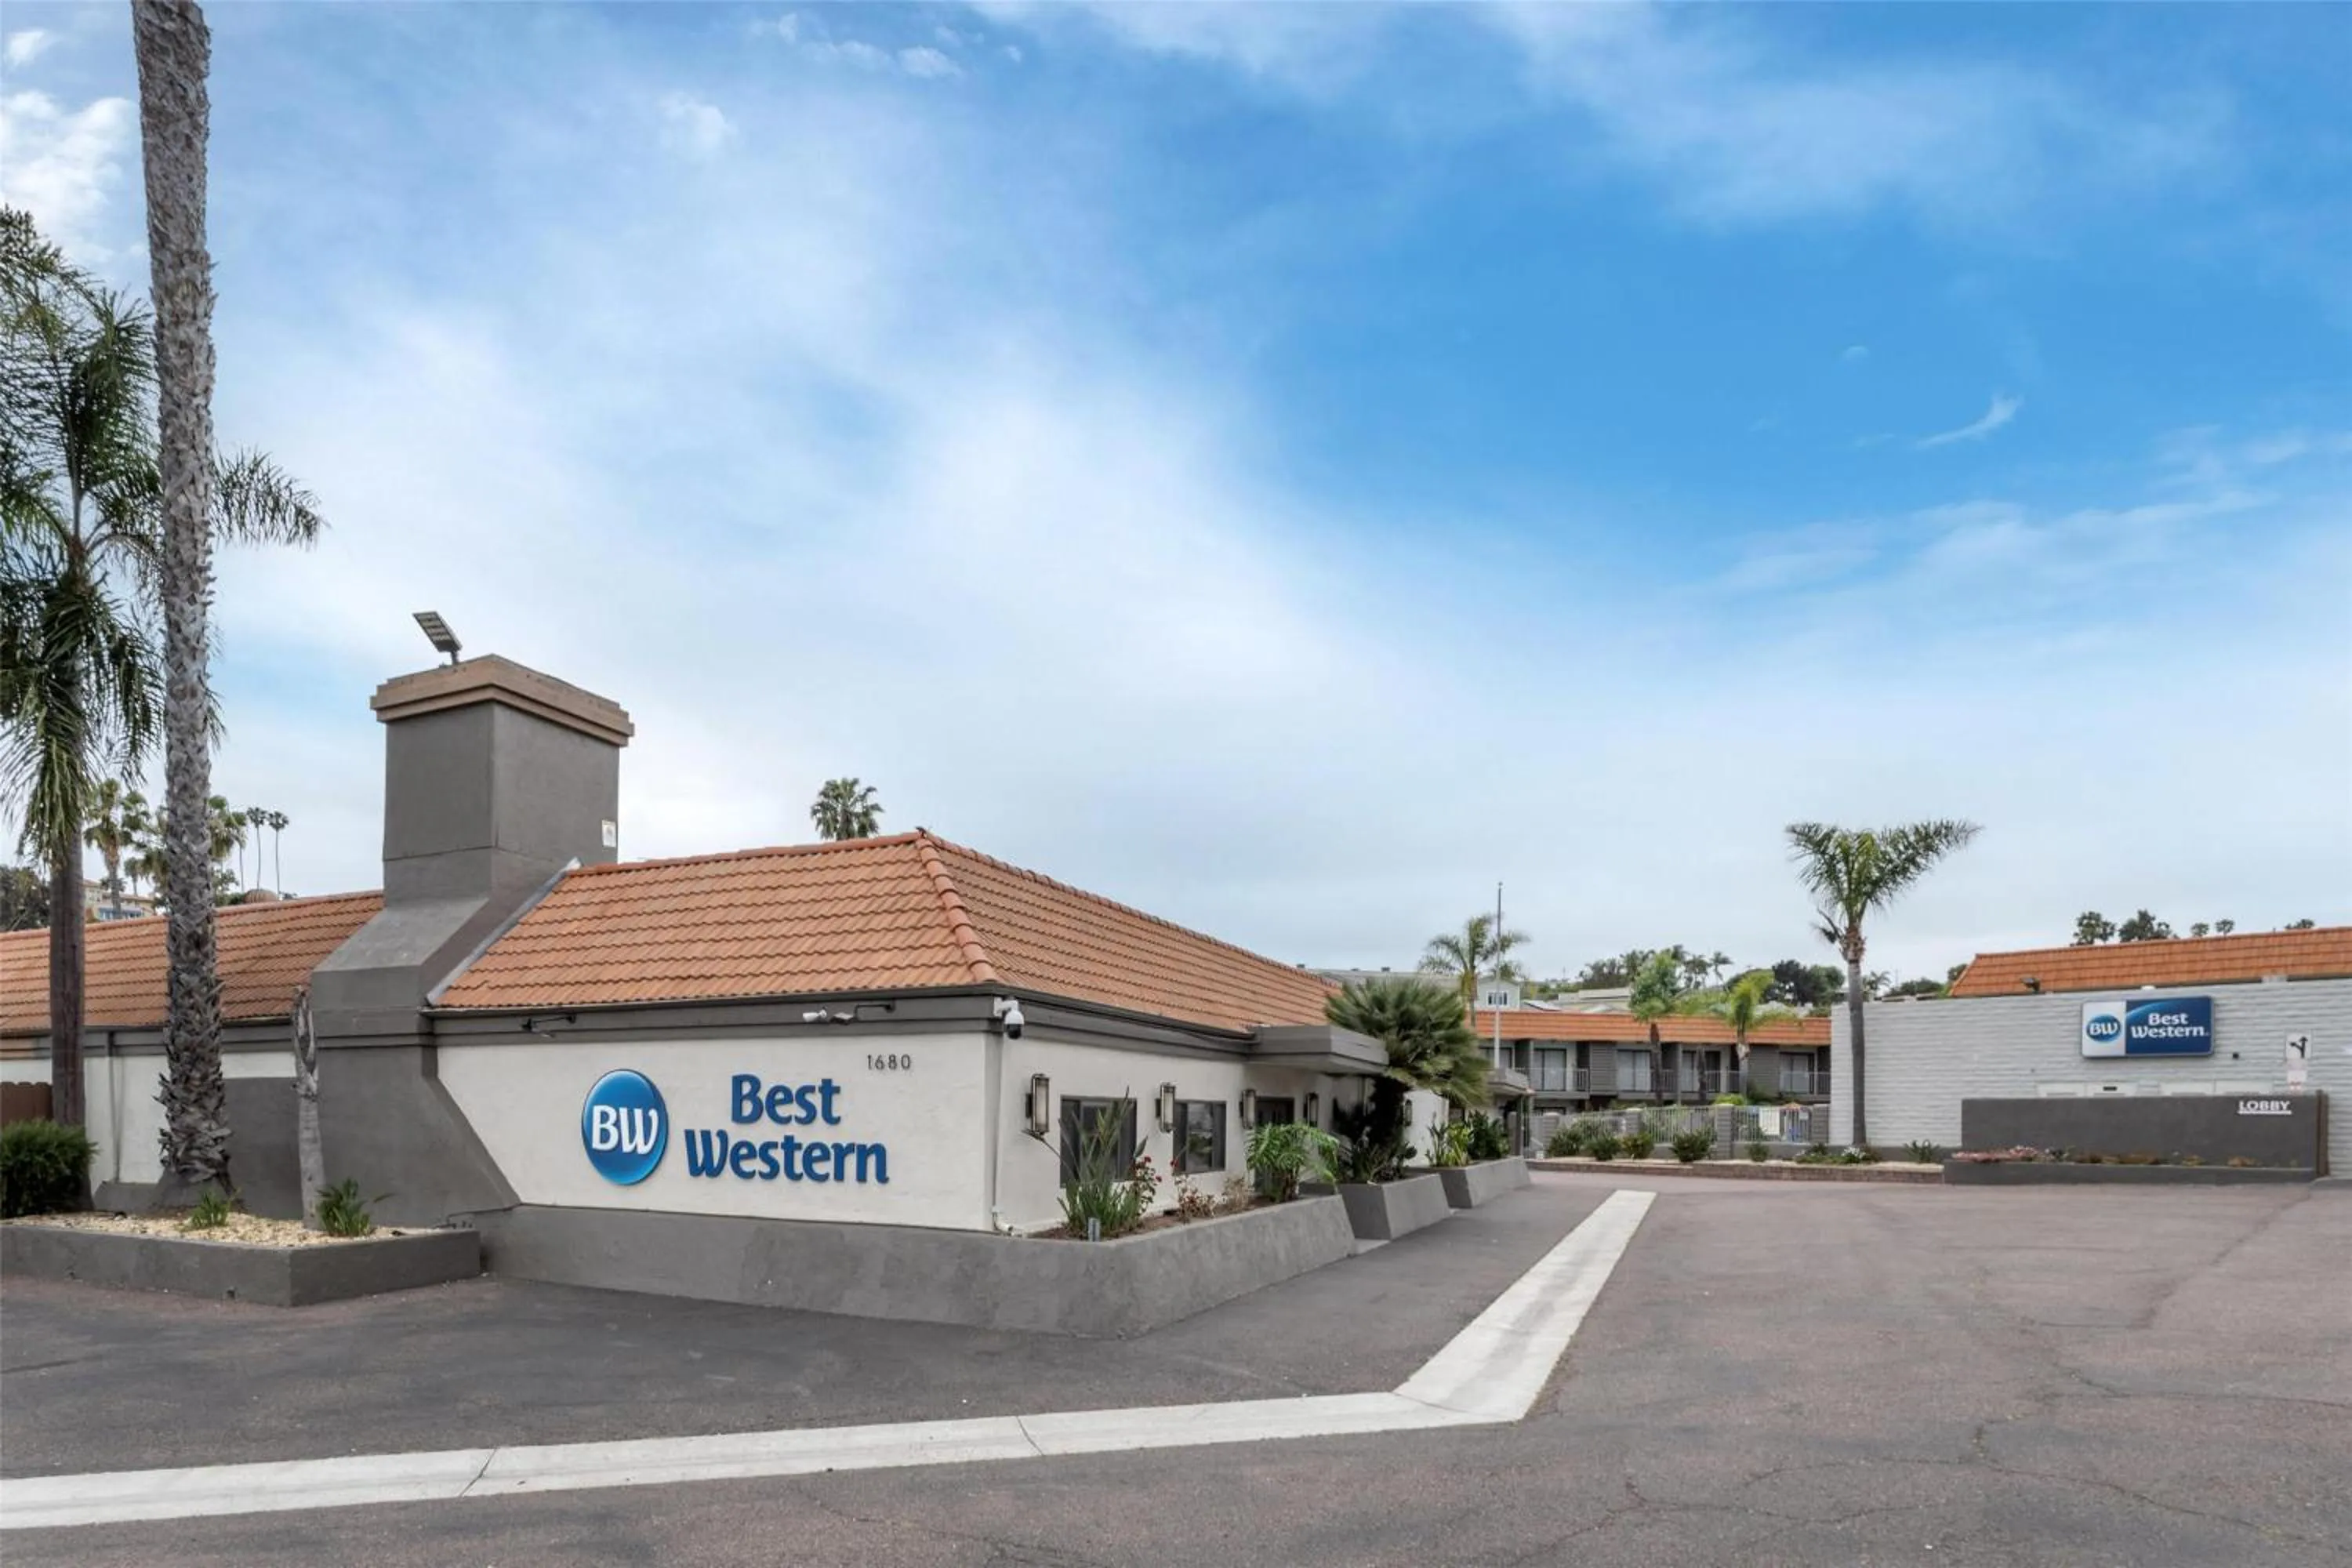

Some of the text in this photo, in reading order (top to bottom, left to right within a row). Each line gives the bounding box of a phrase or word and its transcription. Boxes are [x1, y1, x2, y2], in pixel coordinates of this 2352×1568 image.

[2148, 1013, 2188, 1025] Best
[2089, 1022, 2118, 1035] BW
[2130, 1025, 2205, 1038] Western
[866, 1054, 912, 1071] 1680
[731, 1073, 841, 1126] Best
[2239, 1100, 2291, 1112] LOBBY
[592, 1105, 659, 1154] BW
[684, 1129, 889, 1185] Western
